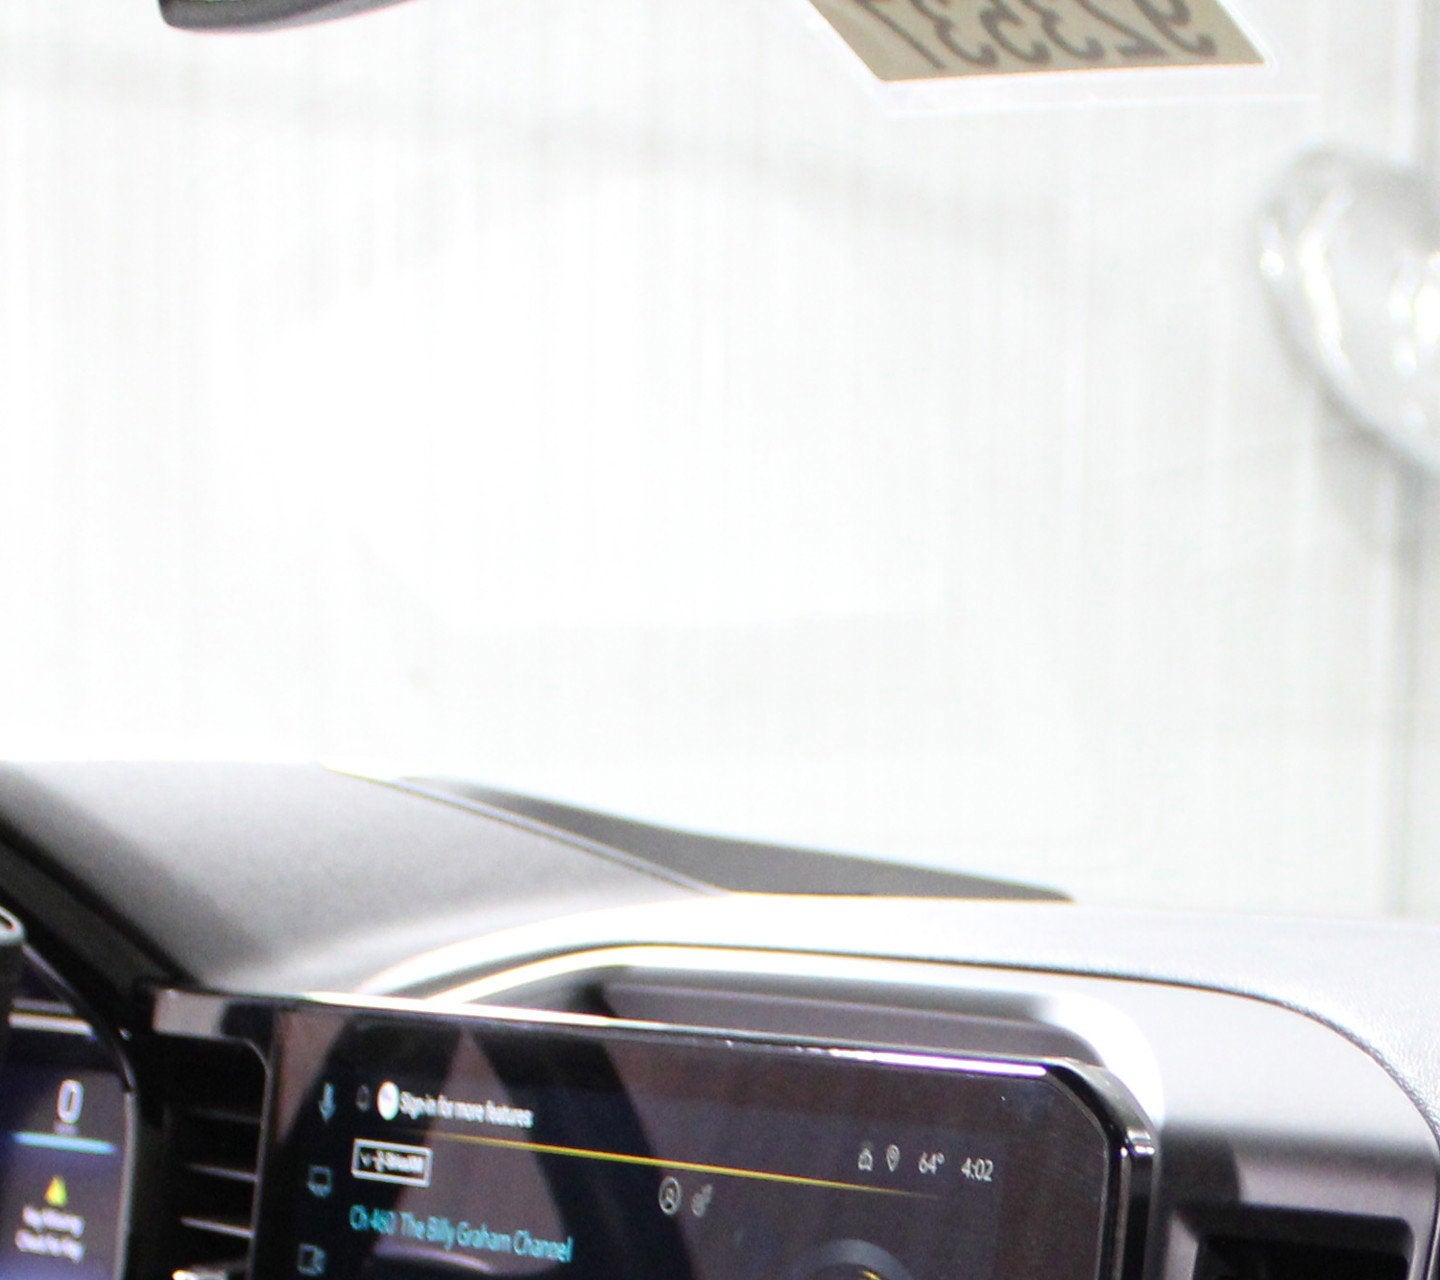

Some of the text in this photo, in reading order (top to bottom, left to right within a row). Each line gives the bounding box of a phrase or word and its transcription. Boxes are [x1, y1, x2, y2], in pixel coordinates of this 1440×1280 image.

[960, 1157, 994, 1182] 4:02
[399, 1211, 425, 1239] The
[426, 1216, 456, 1251] Billy
[456, 1221, 512, 1252] Graham
[513, 1229, 574, 1263] Channel
